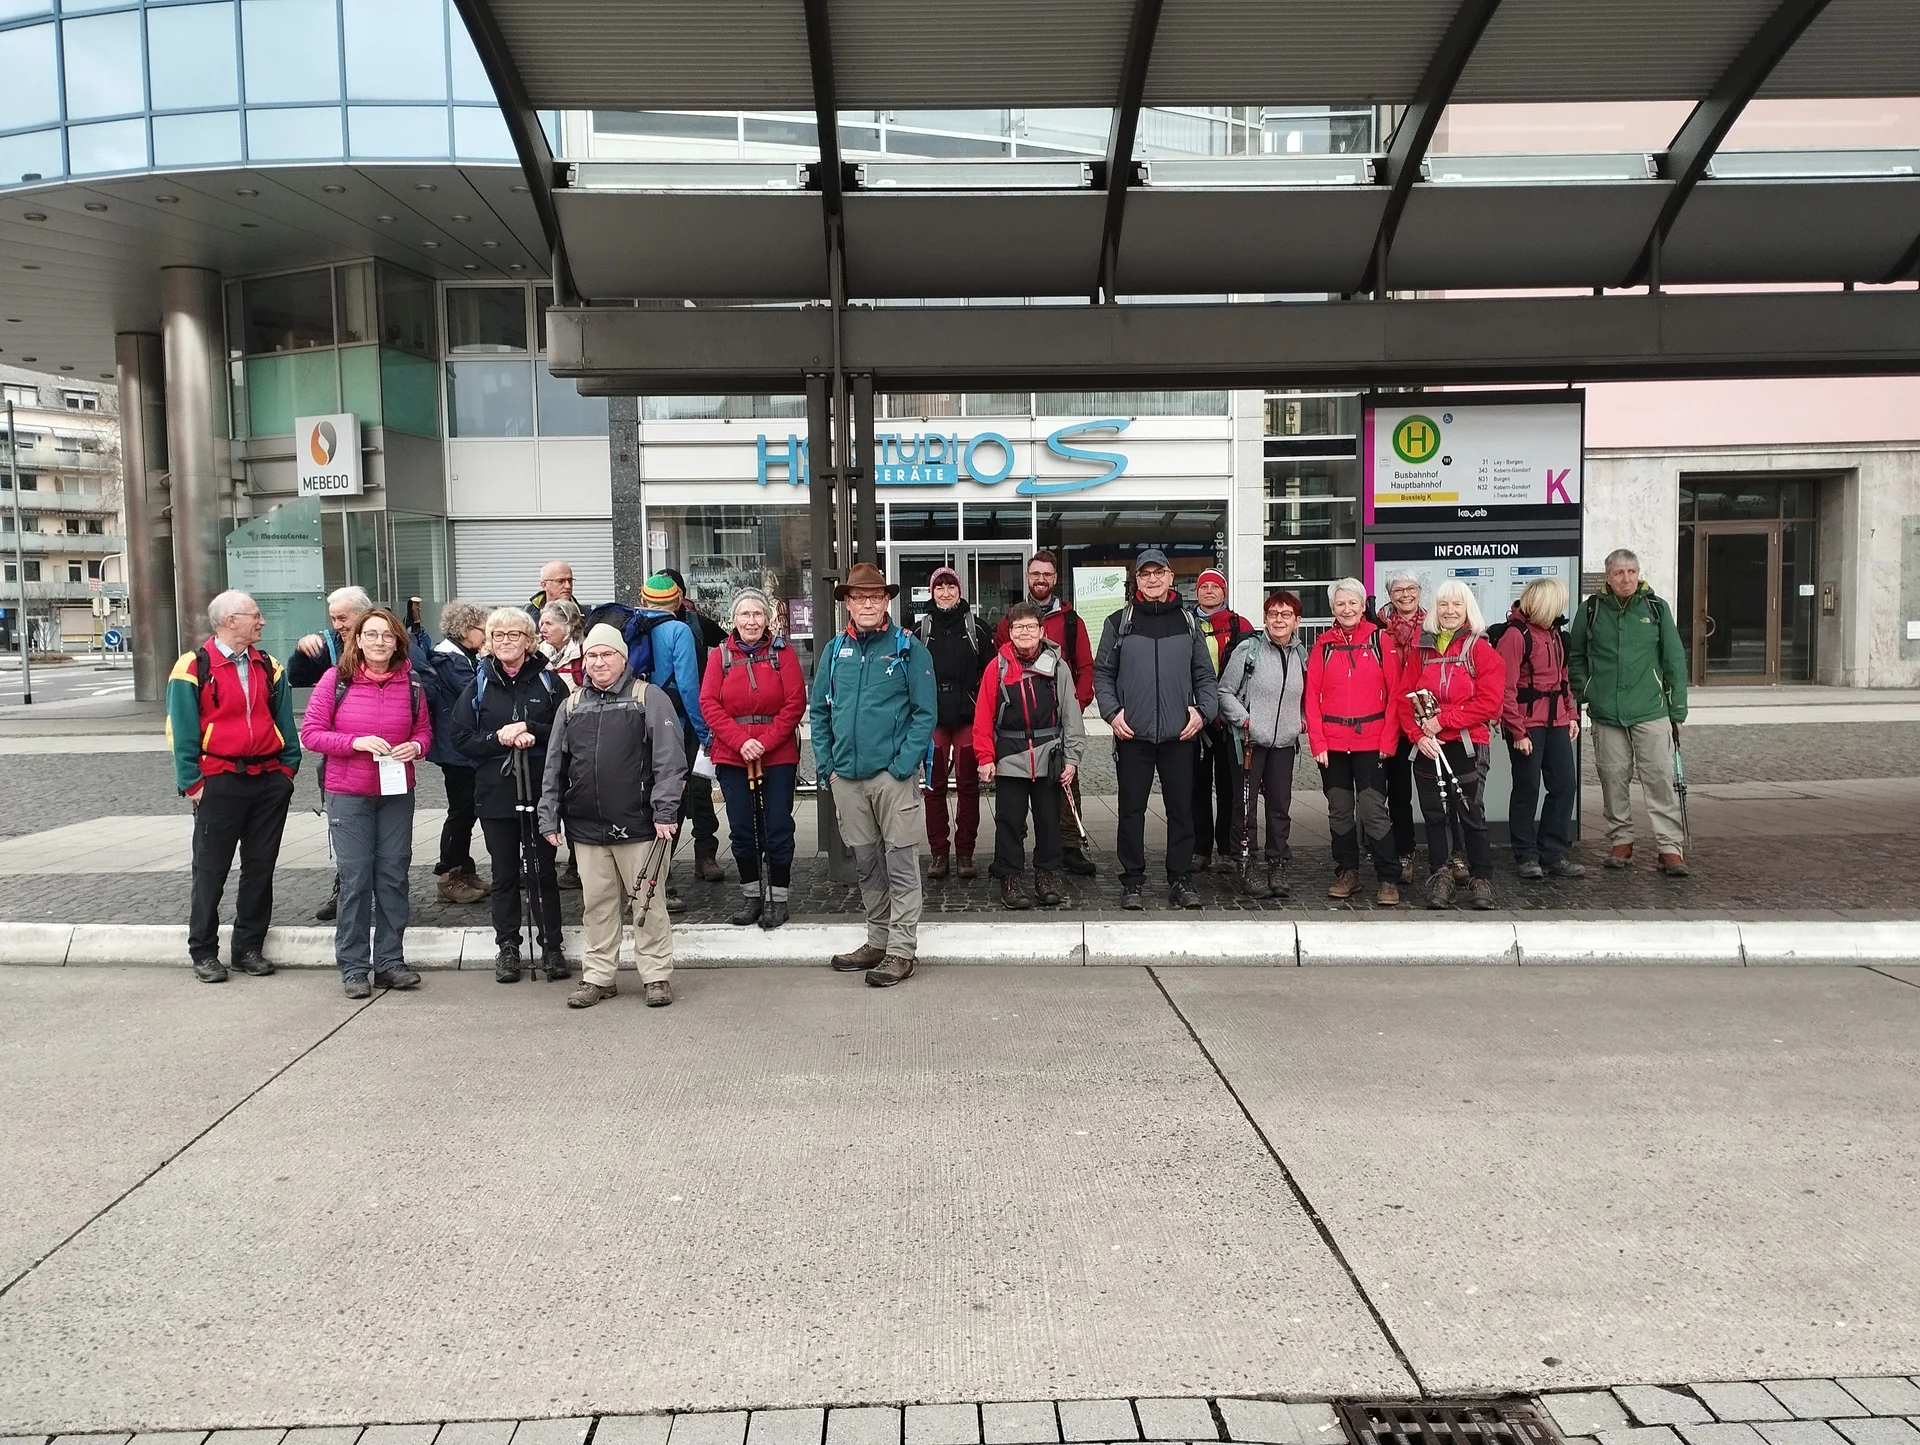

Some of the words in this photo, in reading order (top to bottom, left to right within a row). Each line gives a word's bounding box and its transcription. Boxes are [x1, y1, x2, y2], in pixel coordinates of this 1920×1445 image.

[1407, 426, 1427, 453] H
[1016, 419, 1131, 494] S
[1394, 470, 1439, 479] Busbahnhof
[303, 474, 349, 491] MEBEDO
[1390, 480, 1442, 490] Hauptbahnhof
[1546, 468, 1572, 504] K
[260, 532, 309, 540] MedecoCenter
[1434, 543, 1519, 557] INFORMATION
